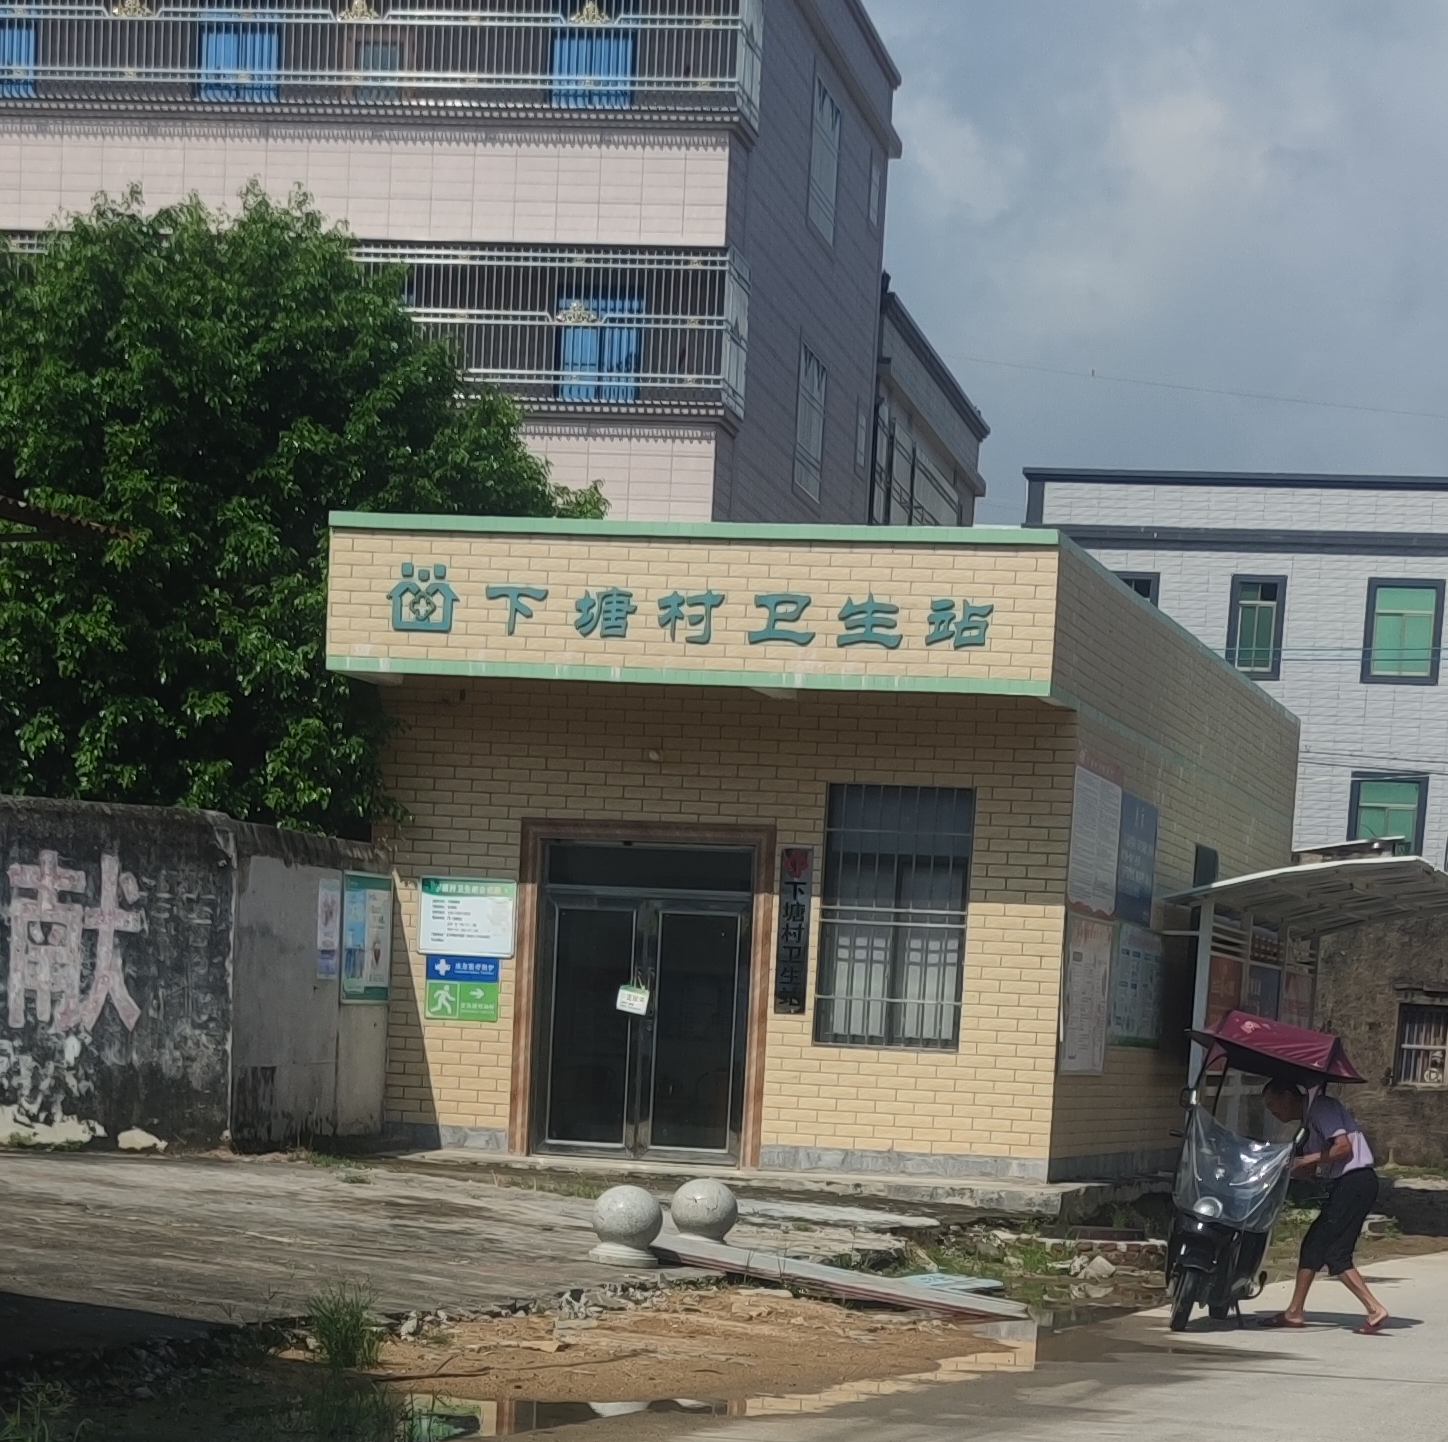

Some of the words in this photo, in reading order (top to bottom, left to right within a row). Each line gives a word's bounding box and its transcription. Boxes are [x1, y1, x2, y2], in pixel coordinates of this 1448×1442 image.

[485, 583, 995, 650] 下塘村卫生站
